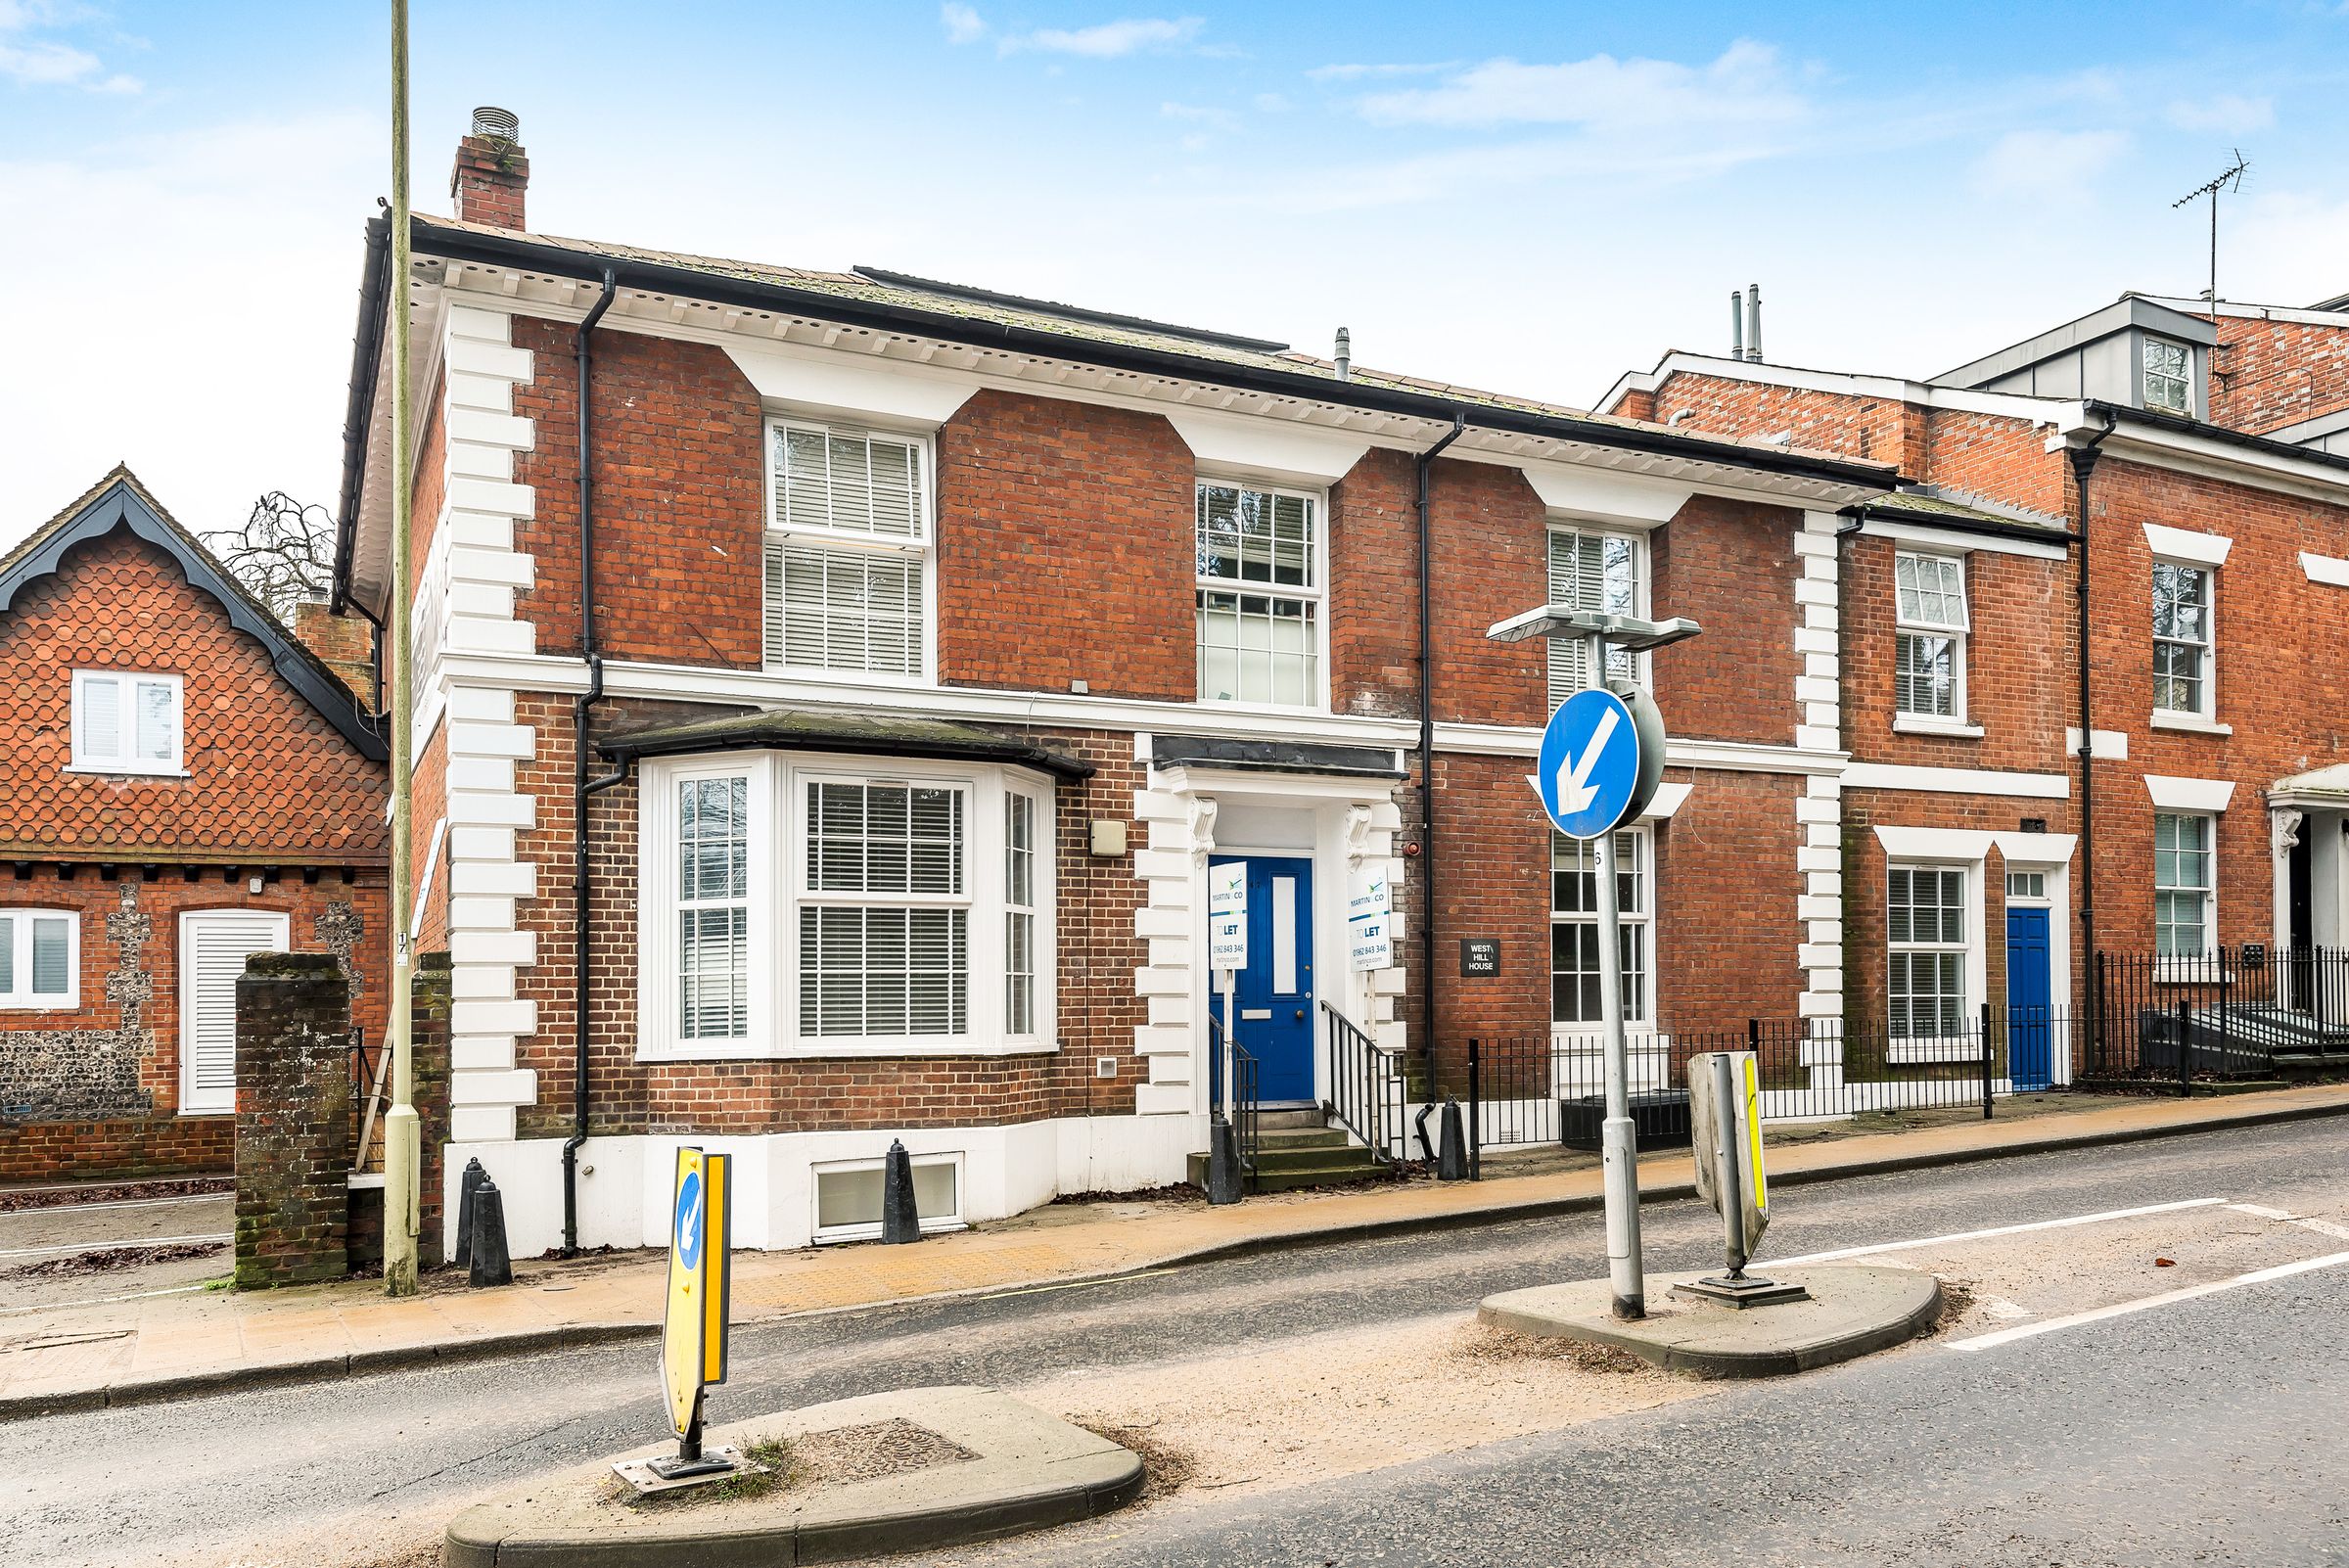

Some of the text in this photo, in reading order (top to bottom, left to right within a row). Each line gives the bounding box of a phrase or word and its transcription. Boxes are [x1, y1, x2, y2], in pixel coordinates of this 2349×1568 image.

[1595, 852, 1601, 865] 6
[1213, 891, 1243, 901] MARTIN CO
[1351, 897, 1370, 907] MARTIN
[1223, 924, 1238, 936] LET
[1357, 926, 1380, 939] TO LET
[1223, 945, 1233, 953] 843
[1233, 944, 1244, 952] 346
[1364, 945, 1375, 954] 843
[1376, 944, 1387, 952] 346
